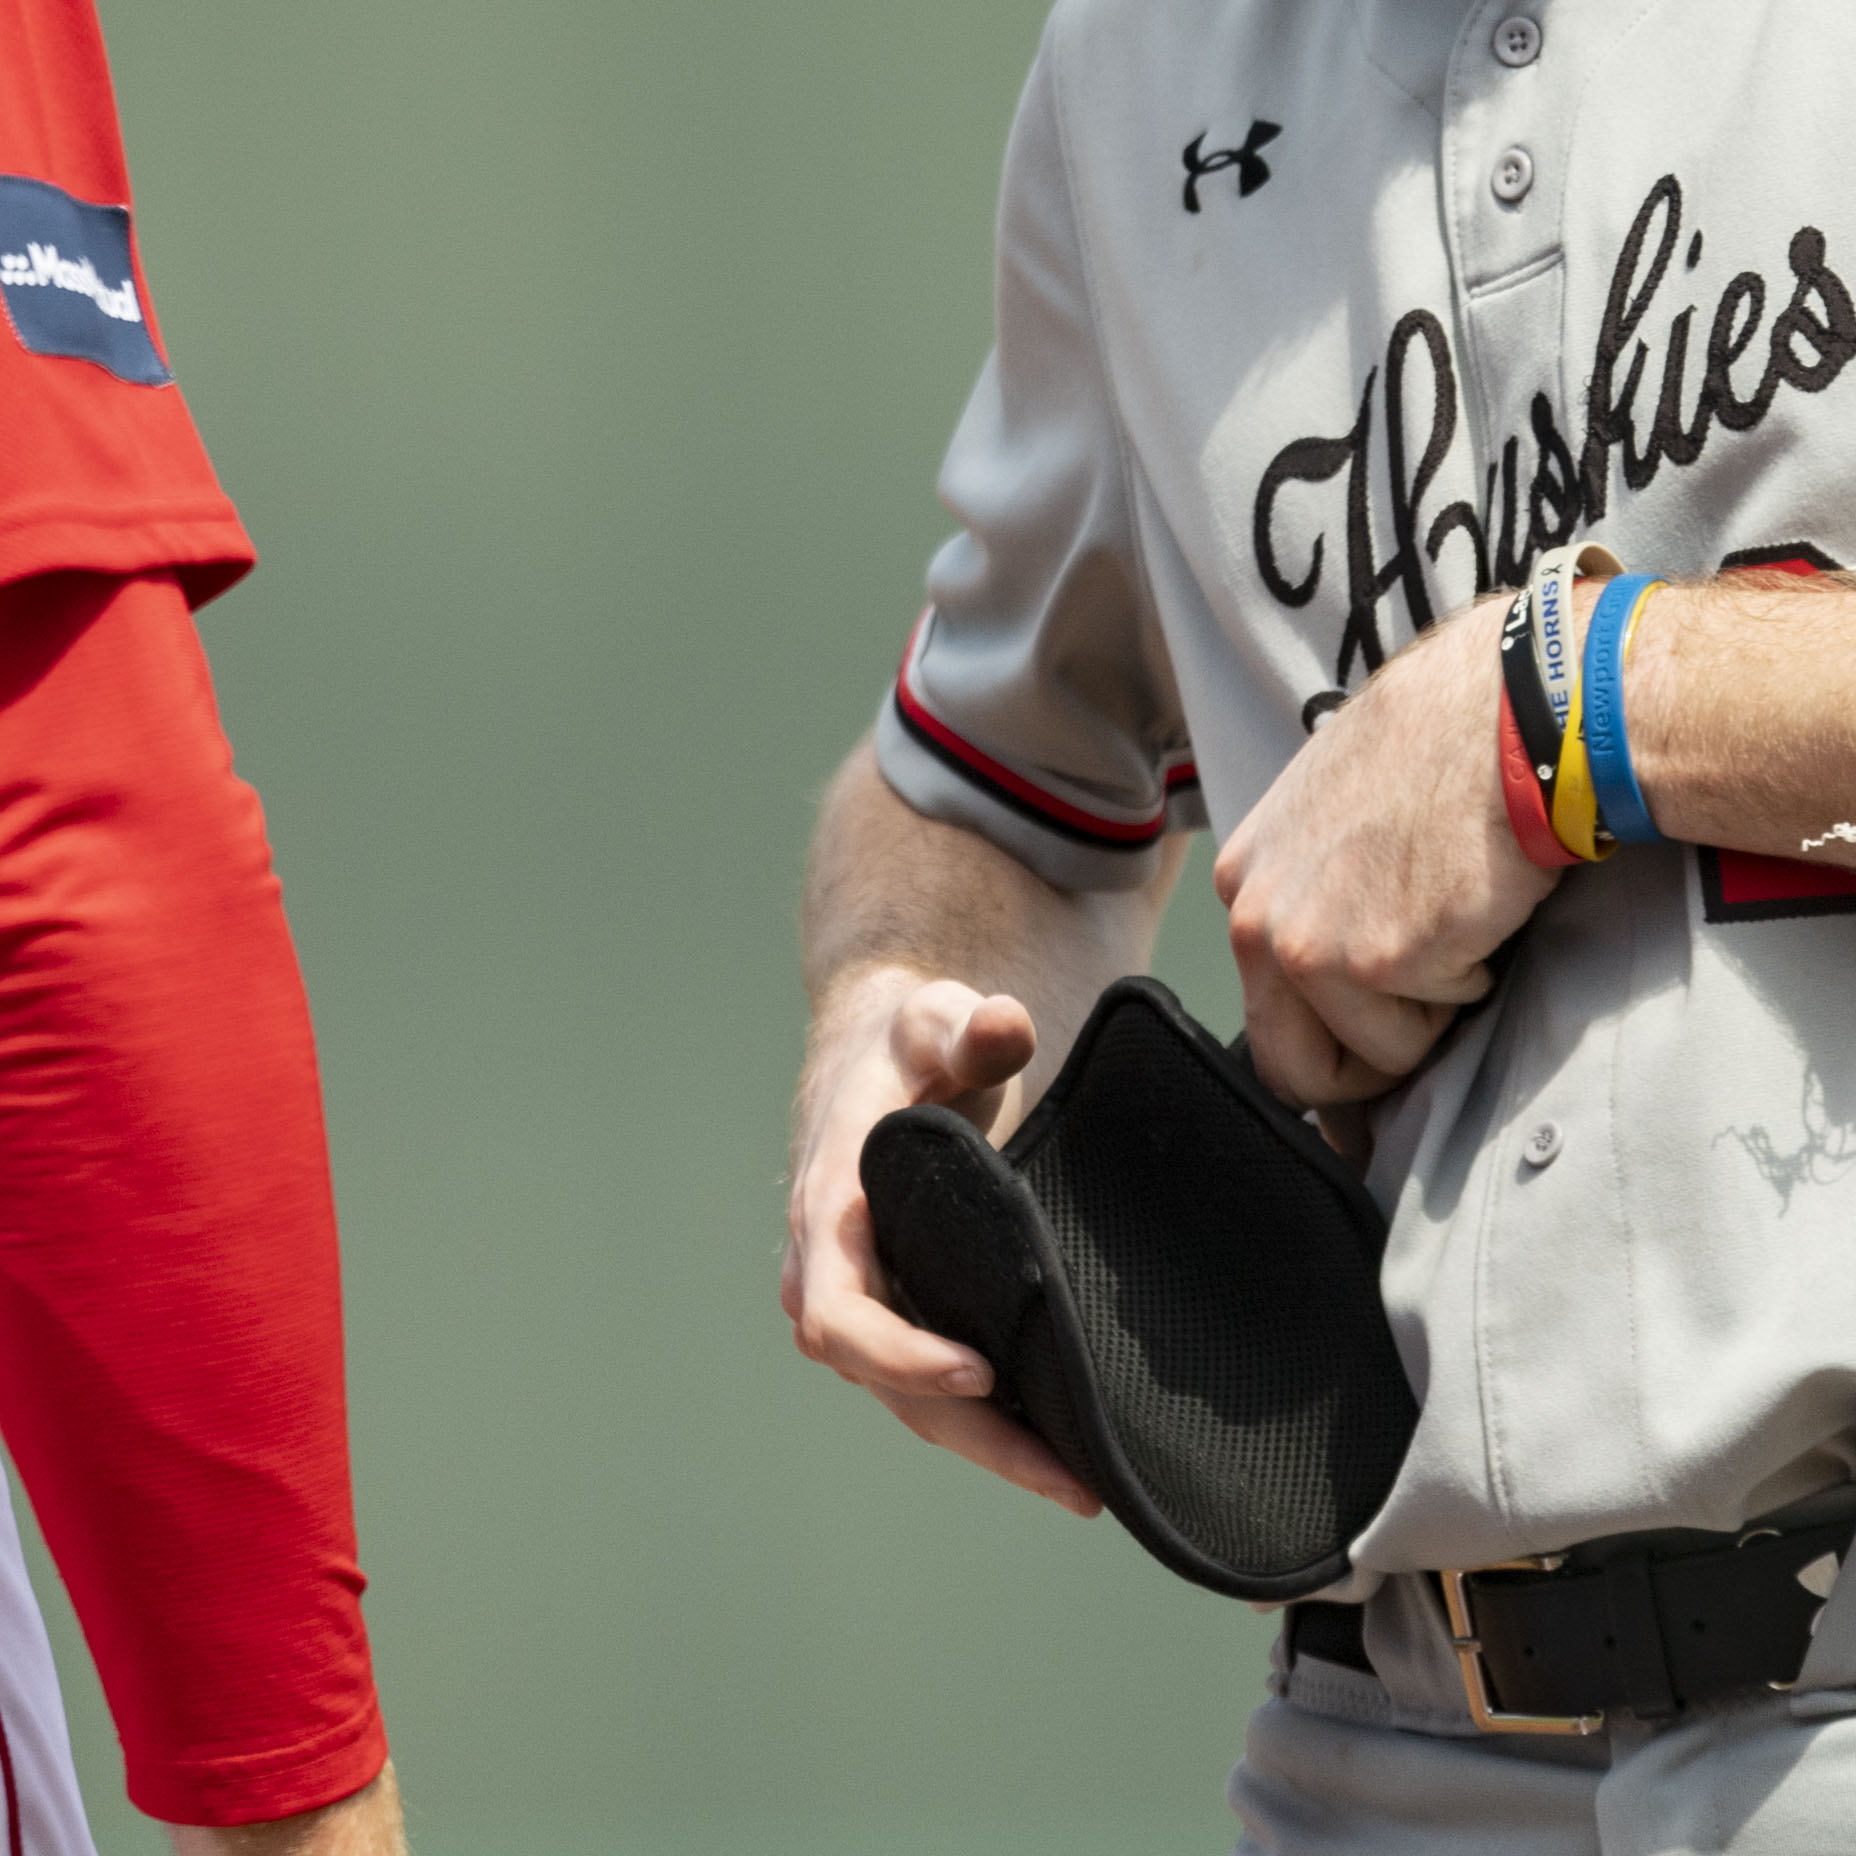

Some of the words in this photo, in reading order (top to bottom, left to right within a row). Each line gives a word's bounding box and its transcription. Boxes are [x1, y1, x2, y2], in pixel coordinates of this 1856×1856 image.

[1541, 579, 1566, 684] HORNS
[1550, 689, 1570, 731] HE
[1591, 625, 1617, 756] Newport
